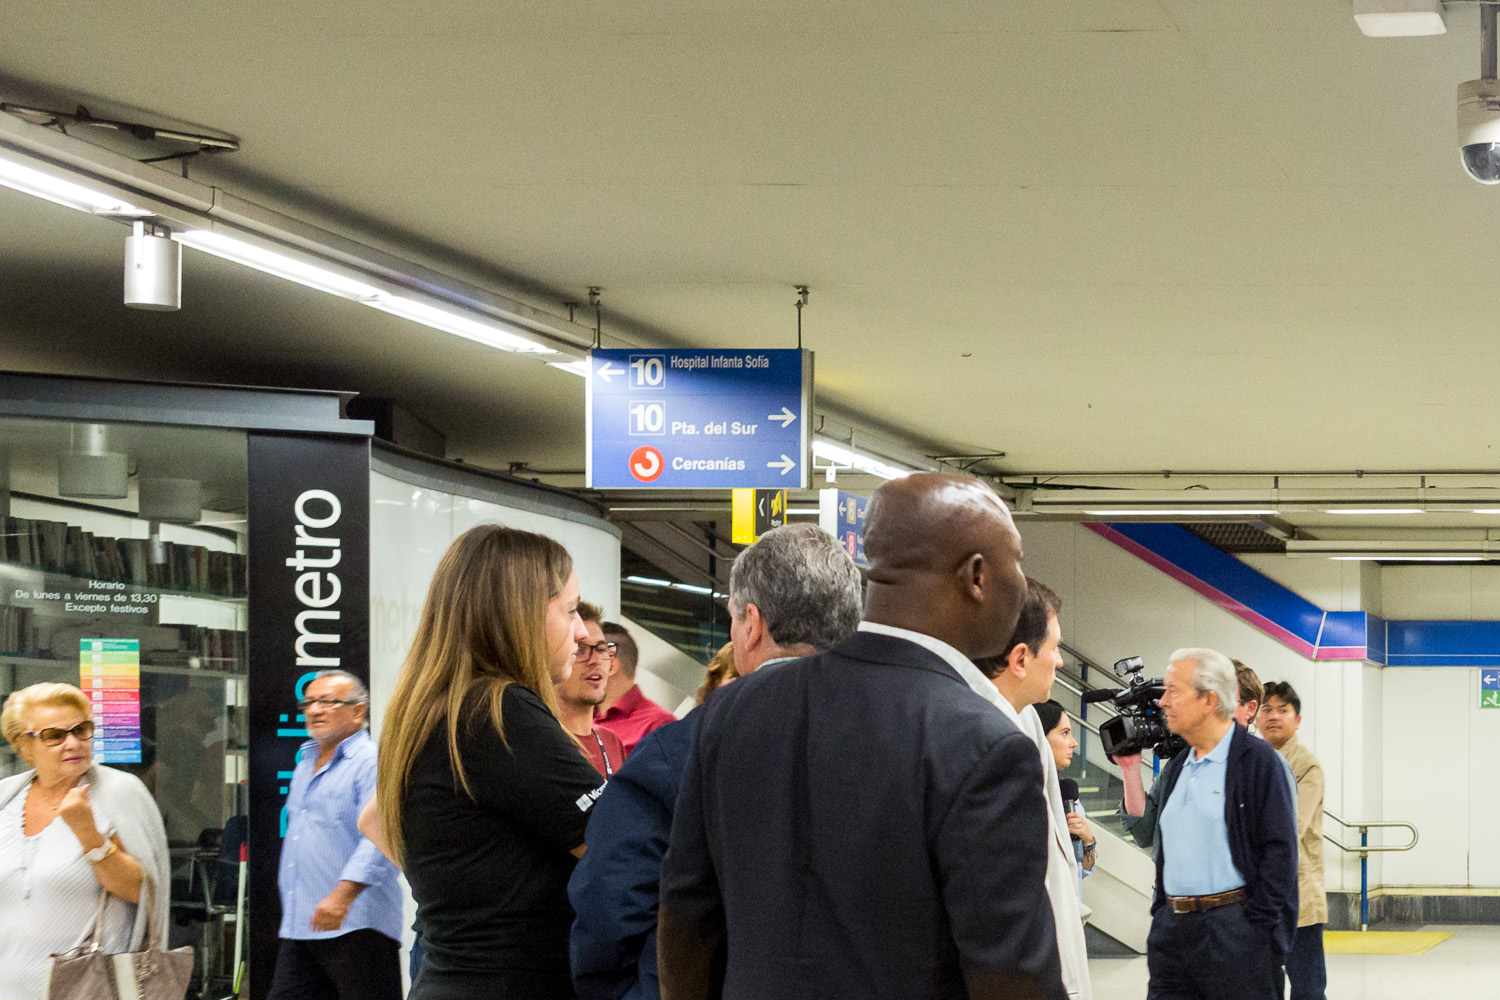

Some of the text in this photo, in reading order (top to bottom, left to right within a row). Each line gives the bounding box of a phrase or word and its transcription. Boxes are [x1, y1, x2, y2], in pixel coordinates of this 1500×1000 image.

[631, 354, 769, 386] 10 Hospital Infanta Sofía
[631, 404, 757, 435] 10 Pta. del Sur
[672, 456, 746, 471] Cercanías
[88, 579, 126, 590] Horario
[15, 589, 30, 600] De
[33, 590, 61, 601] lunes
[64, 593, 72, 601] a
[74, 592, 111, 602] viernes
[113, 593, 127, 603] de
[65, 602, 149, 614] Excepto festivos
